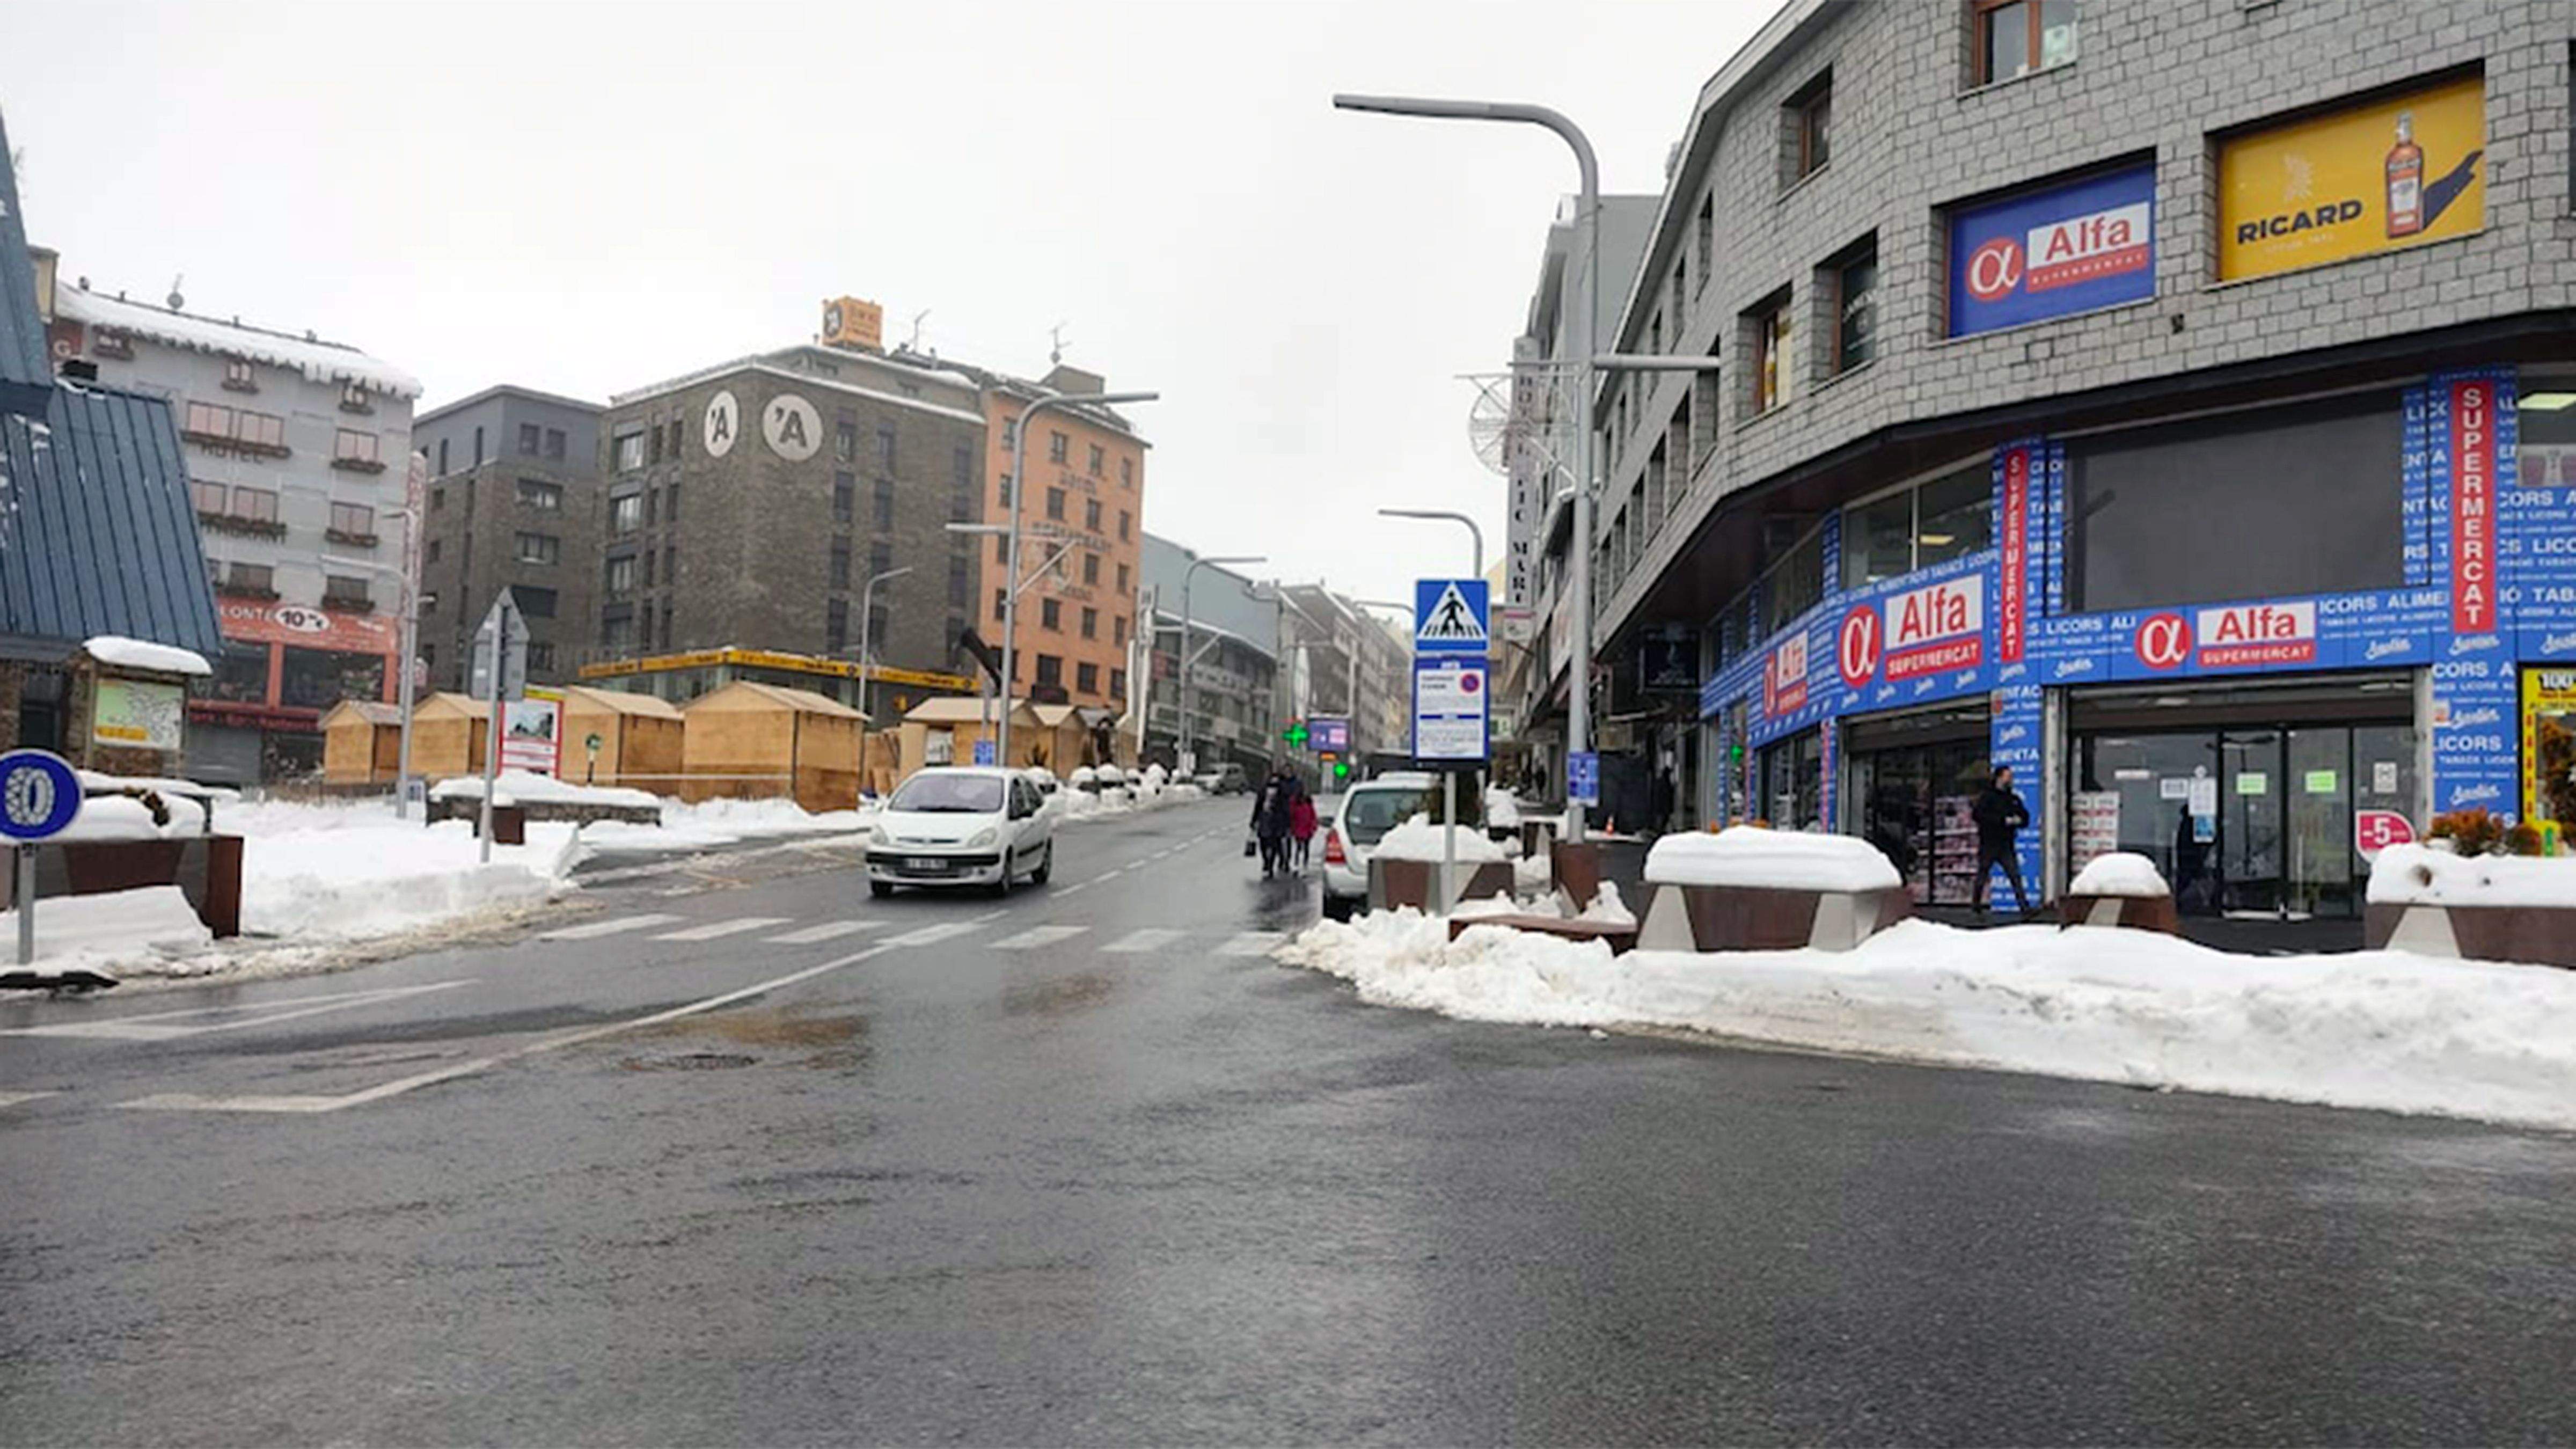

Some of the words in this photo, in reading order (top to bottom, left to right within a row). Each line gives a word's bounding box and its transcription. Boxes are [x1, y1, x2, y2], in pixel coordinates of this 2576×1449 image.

[2046, 216, 2131, 261] Alfa
[2237, 200, 2362, 244] RICARD
[2462, 387, 2485, 625] SUPERMERCAT
[2005, 455, 2021, 657] SUPERMERCAT
[1899, 587, 1966, 642] Alfa
[2216, 606, 2295, 641] Alfa
[1888, 642, 1979, 675] SUPERMERCAT
[2203, 643, 2311, 663] SUPERMERCAT
